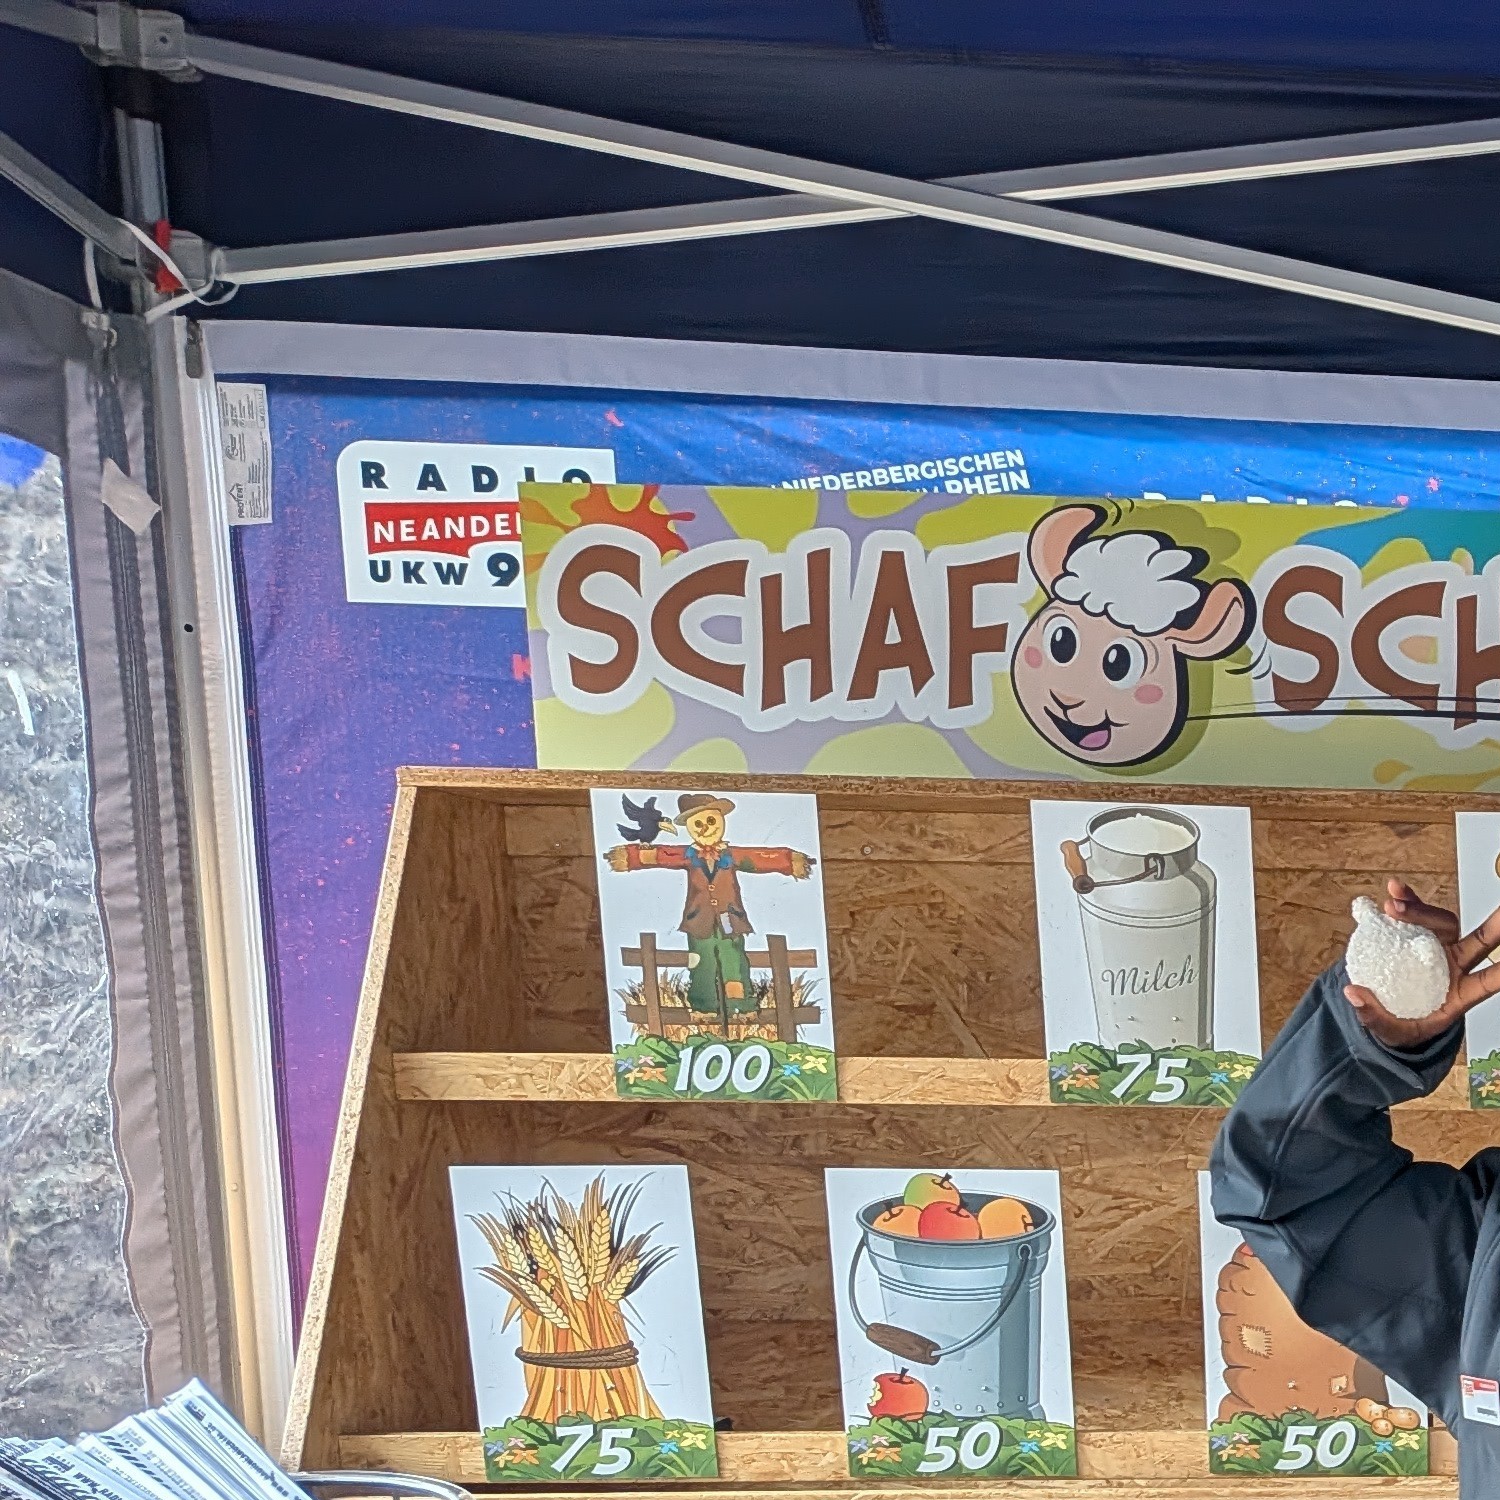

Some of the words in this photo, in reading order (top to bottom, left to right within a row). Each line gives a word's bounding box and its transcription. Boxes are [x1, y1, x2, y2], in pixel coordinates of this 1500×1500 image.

[373, 511, 521, 543] NEANDE
[369, 560, 468, 586] UKW
[557, 545, 1019, 711] SCHAF
[1101, 955, 1199, 997] Milch
[674, 1044, 774, 1094] 100
[1109, 1054, 1190, 1103] 75
[551, 1424, 635, 1469] 75
[916, 1421, 1000, 1472] 50
[1275, 1424, 1359, 1471] 50
